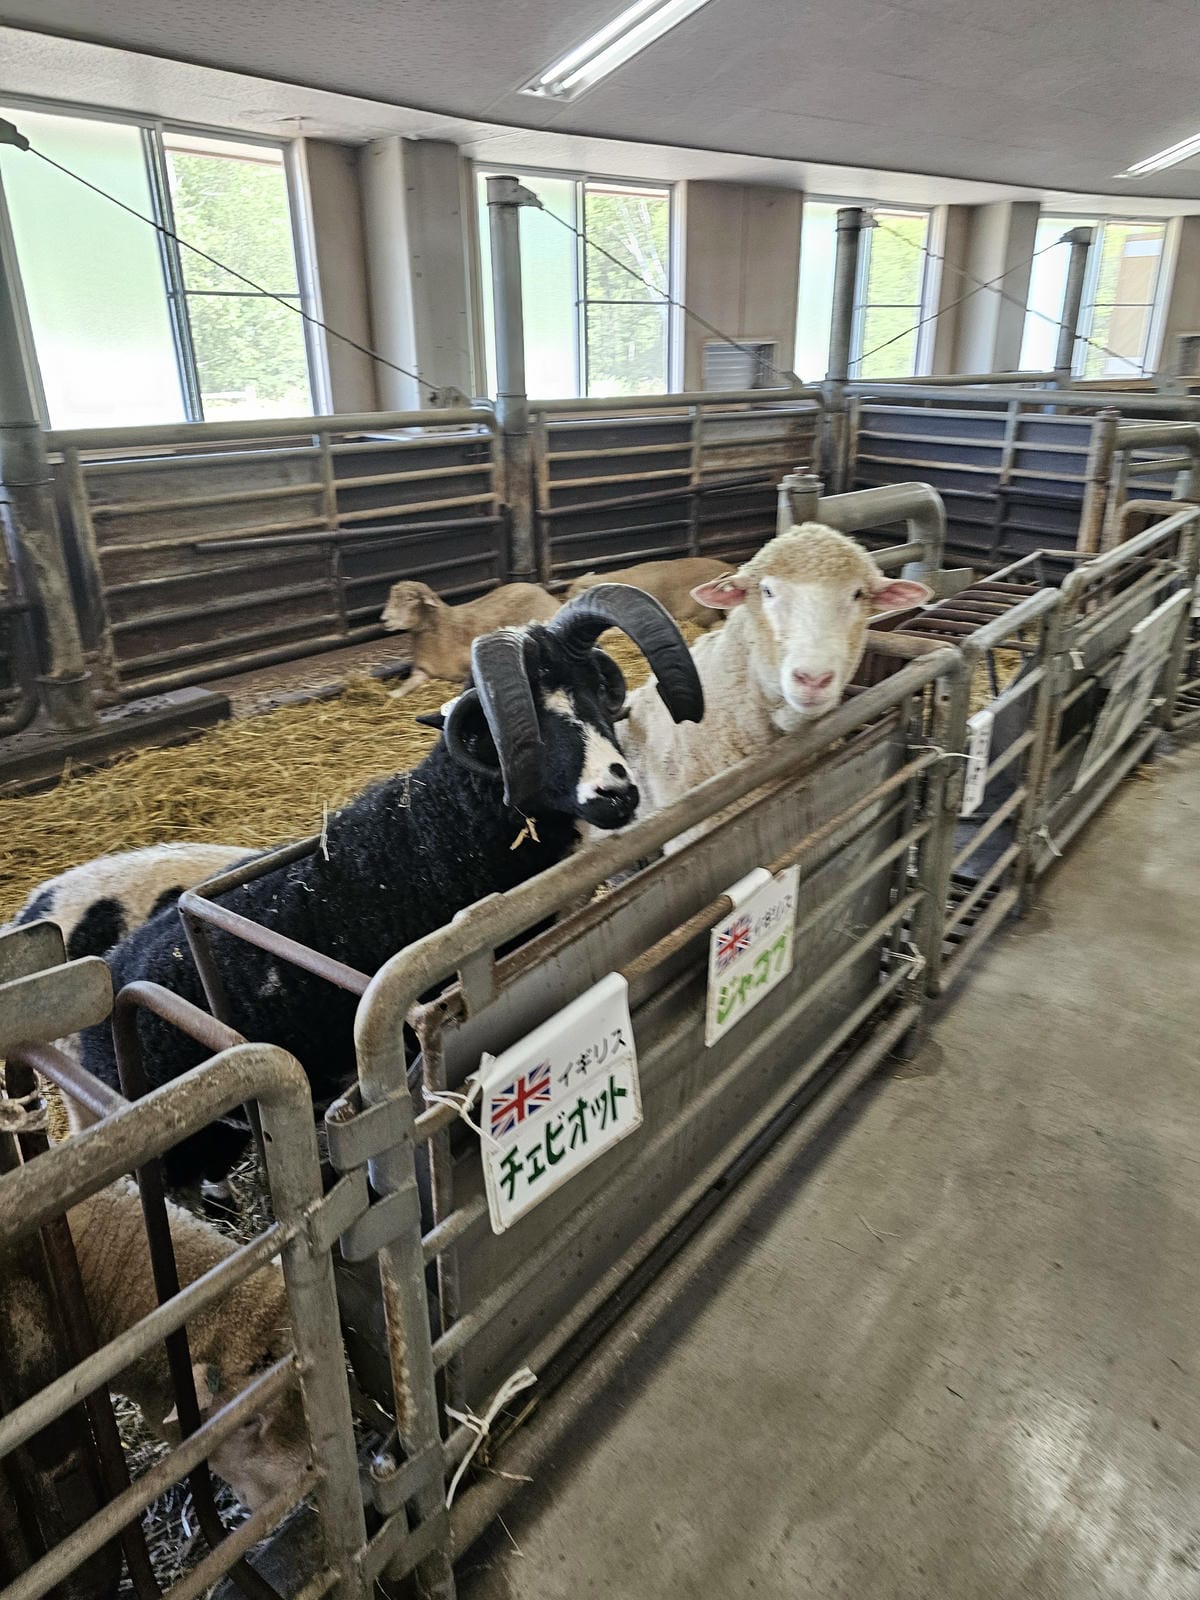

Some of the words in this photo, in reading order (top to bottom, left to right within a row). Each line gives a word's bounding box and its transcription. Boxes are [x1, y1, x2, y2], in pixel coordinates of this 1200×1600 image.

[557, 1028, 627, 1087] イギリス
[499, 1074, 629, 1202] チェビオット
